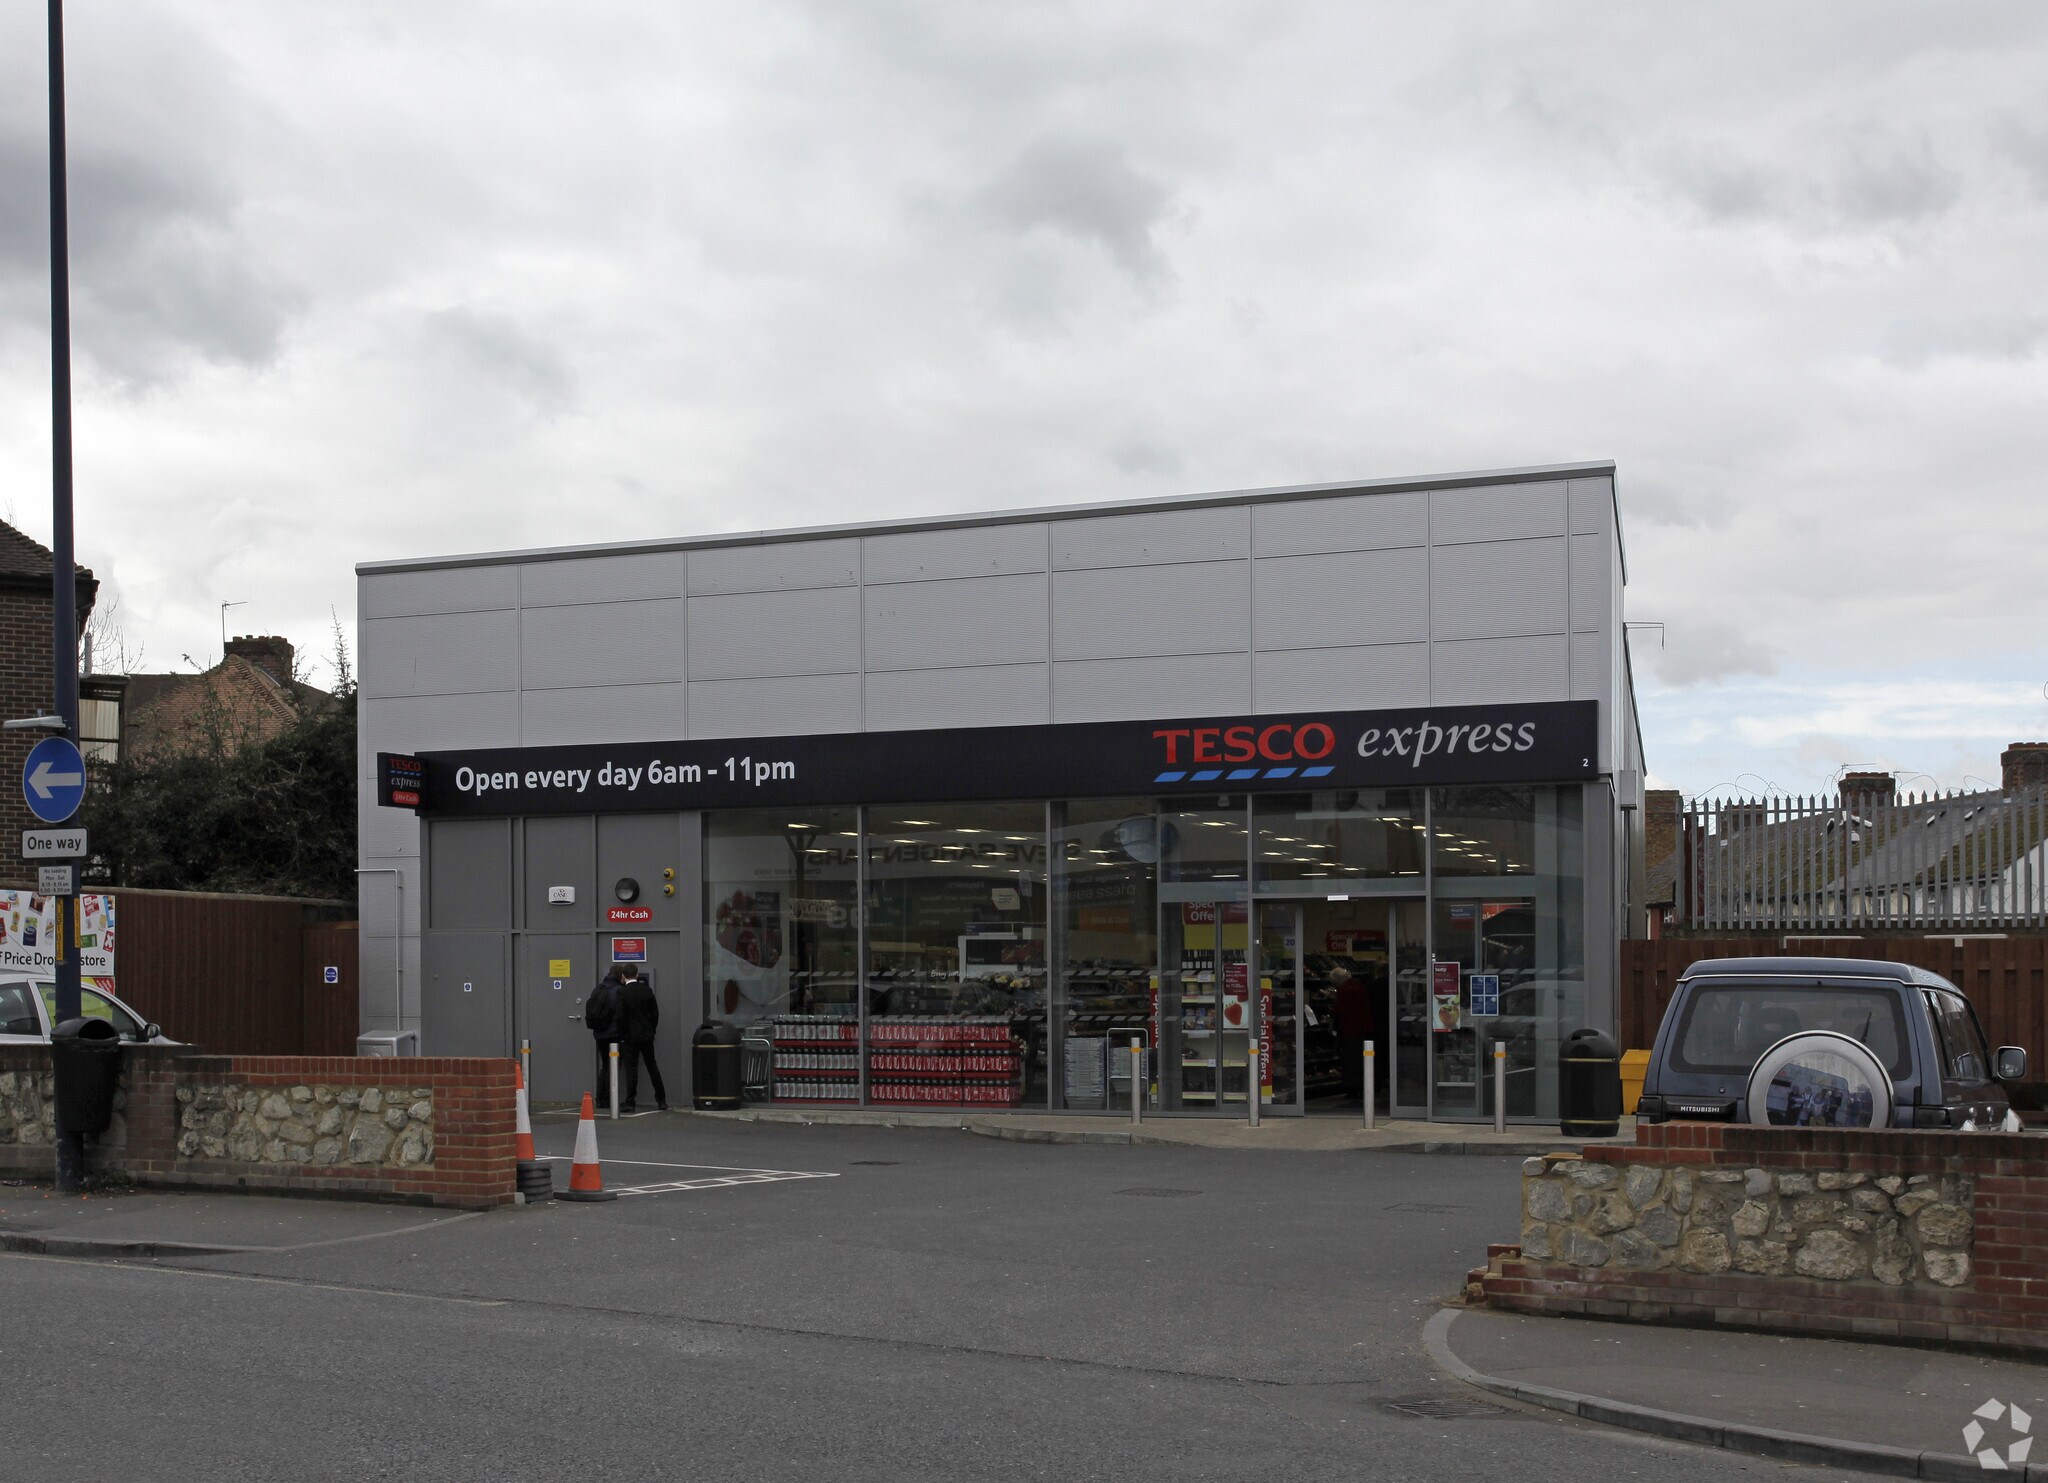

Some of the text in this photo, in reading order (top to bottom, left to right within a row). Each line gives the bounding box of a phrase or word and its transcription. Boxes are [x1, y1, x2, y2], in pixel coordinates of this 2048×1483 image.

[1153, 720, 1536, 767] TESCO express
[389, 758, 422, 771] TESCO
[1582, 758, 1589, 767] 2
[455, 766, 519, 795] Open
[524, 767, 592, 793] every
[597, 762, 643, 791] day
[647, 759, 702, 785] 6am
[724, 756, 796, 786] 11pm
[391, 777, 421, 789] express
[27, 836, 82, 851] One way
[611, 910, 649, 919] 24hr Cash
[1190, 911, 1214, 921] Offe
[4, 951, 32, 965] Price
[34, 953, 55, 965] Dro
[80, 955, 106, 966] store
